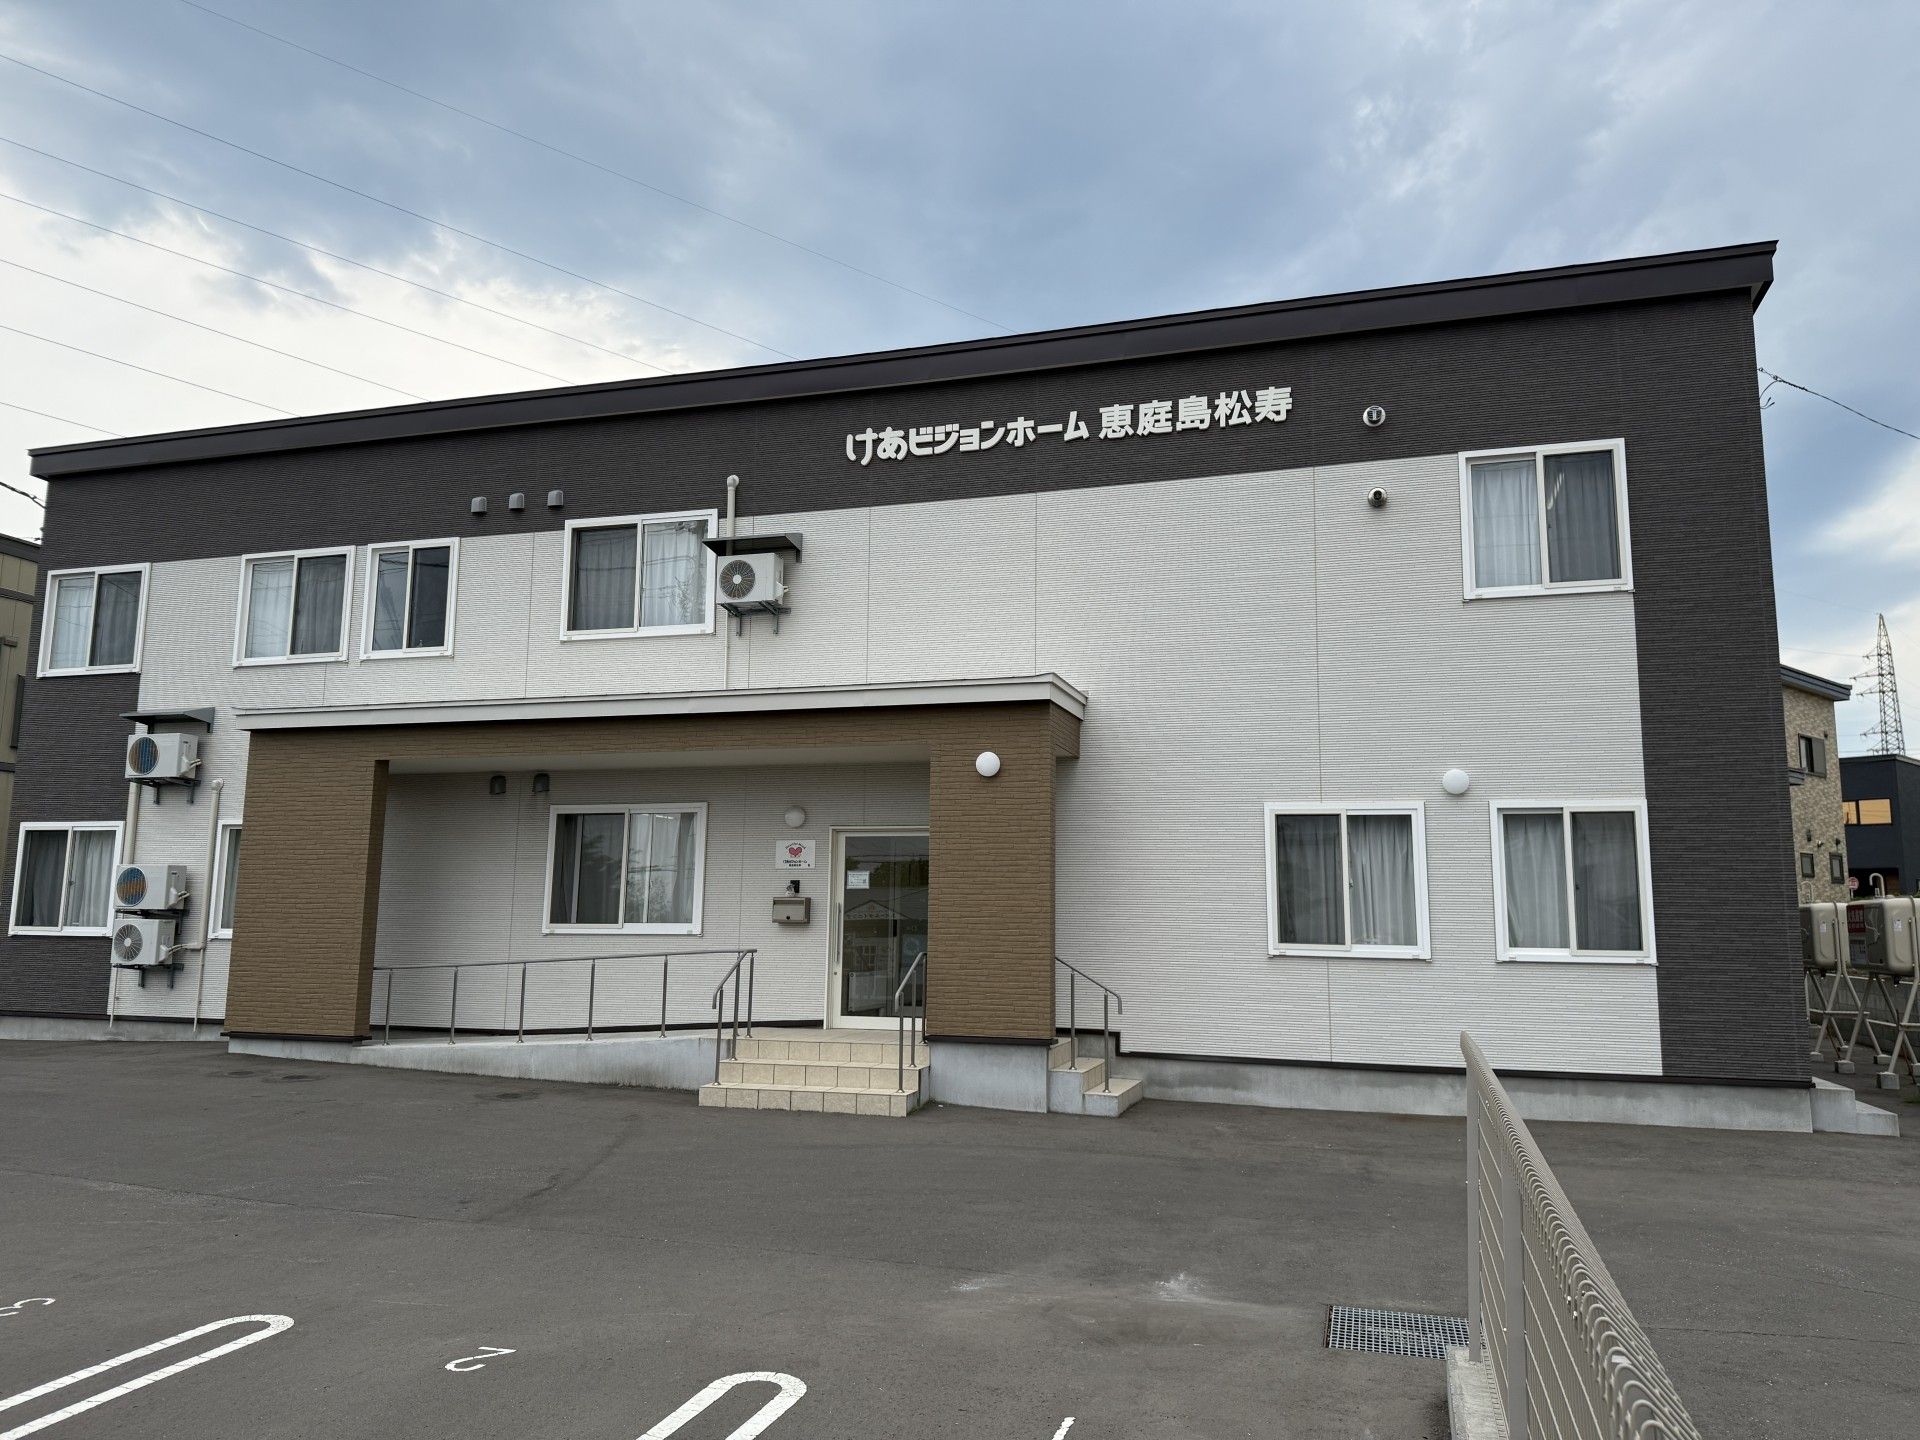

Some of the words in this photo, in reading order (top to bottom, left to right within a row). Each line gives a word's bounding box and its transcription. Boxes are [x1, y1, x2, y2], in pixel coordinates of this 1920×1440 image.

[845, 410, 1090, 466] けあビジョンホーム
[1098, 386, 1293, 440] 恵庭島松寿
[444, 1346, 517, 1372] 2
